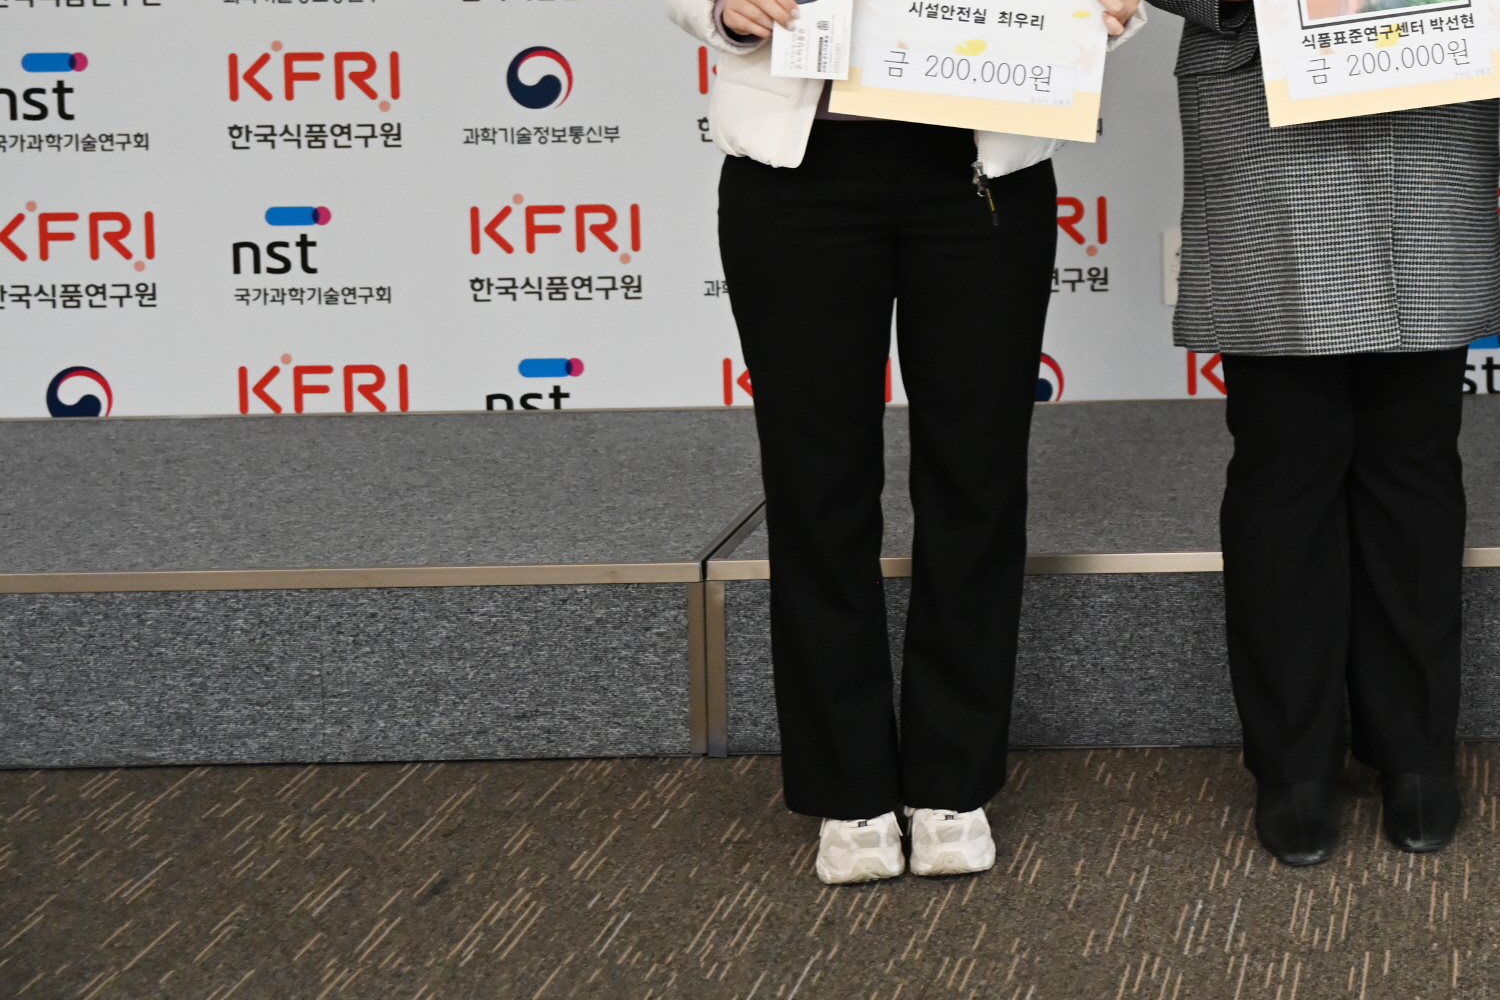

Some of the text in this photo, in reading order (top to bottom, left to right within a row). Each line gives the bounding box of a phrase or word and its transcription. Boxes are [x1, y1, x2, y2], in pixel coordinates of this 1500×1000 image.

[907, 1, 1044, 30] 시설안전실 최우리
[1301, 13, 1475, 50] 식품표준연구센터 박선현
[229, 52, 400, 101] KFRI
[884, 50, 909, 77] 금
[1306, 58, 1331, 85] 금
[228, 123, 402, 149] 한국식품연구원
[463, 126, 620, 145] 과학기술정보통신부
[471, 204, 640, 254] KFRI
[233, 234, 317, 274] nst
[234, 286, 391, 305] 국가과학기술연구회
[470, 275, 642, 302] 한국식품연구원
[239, 364, 408, 414] KFRI
